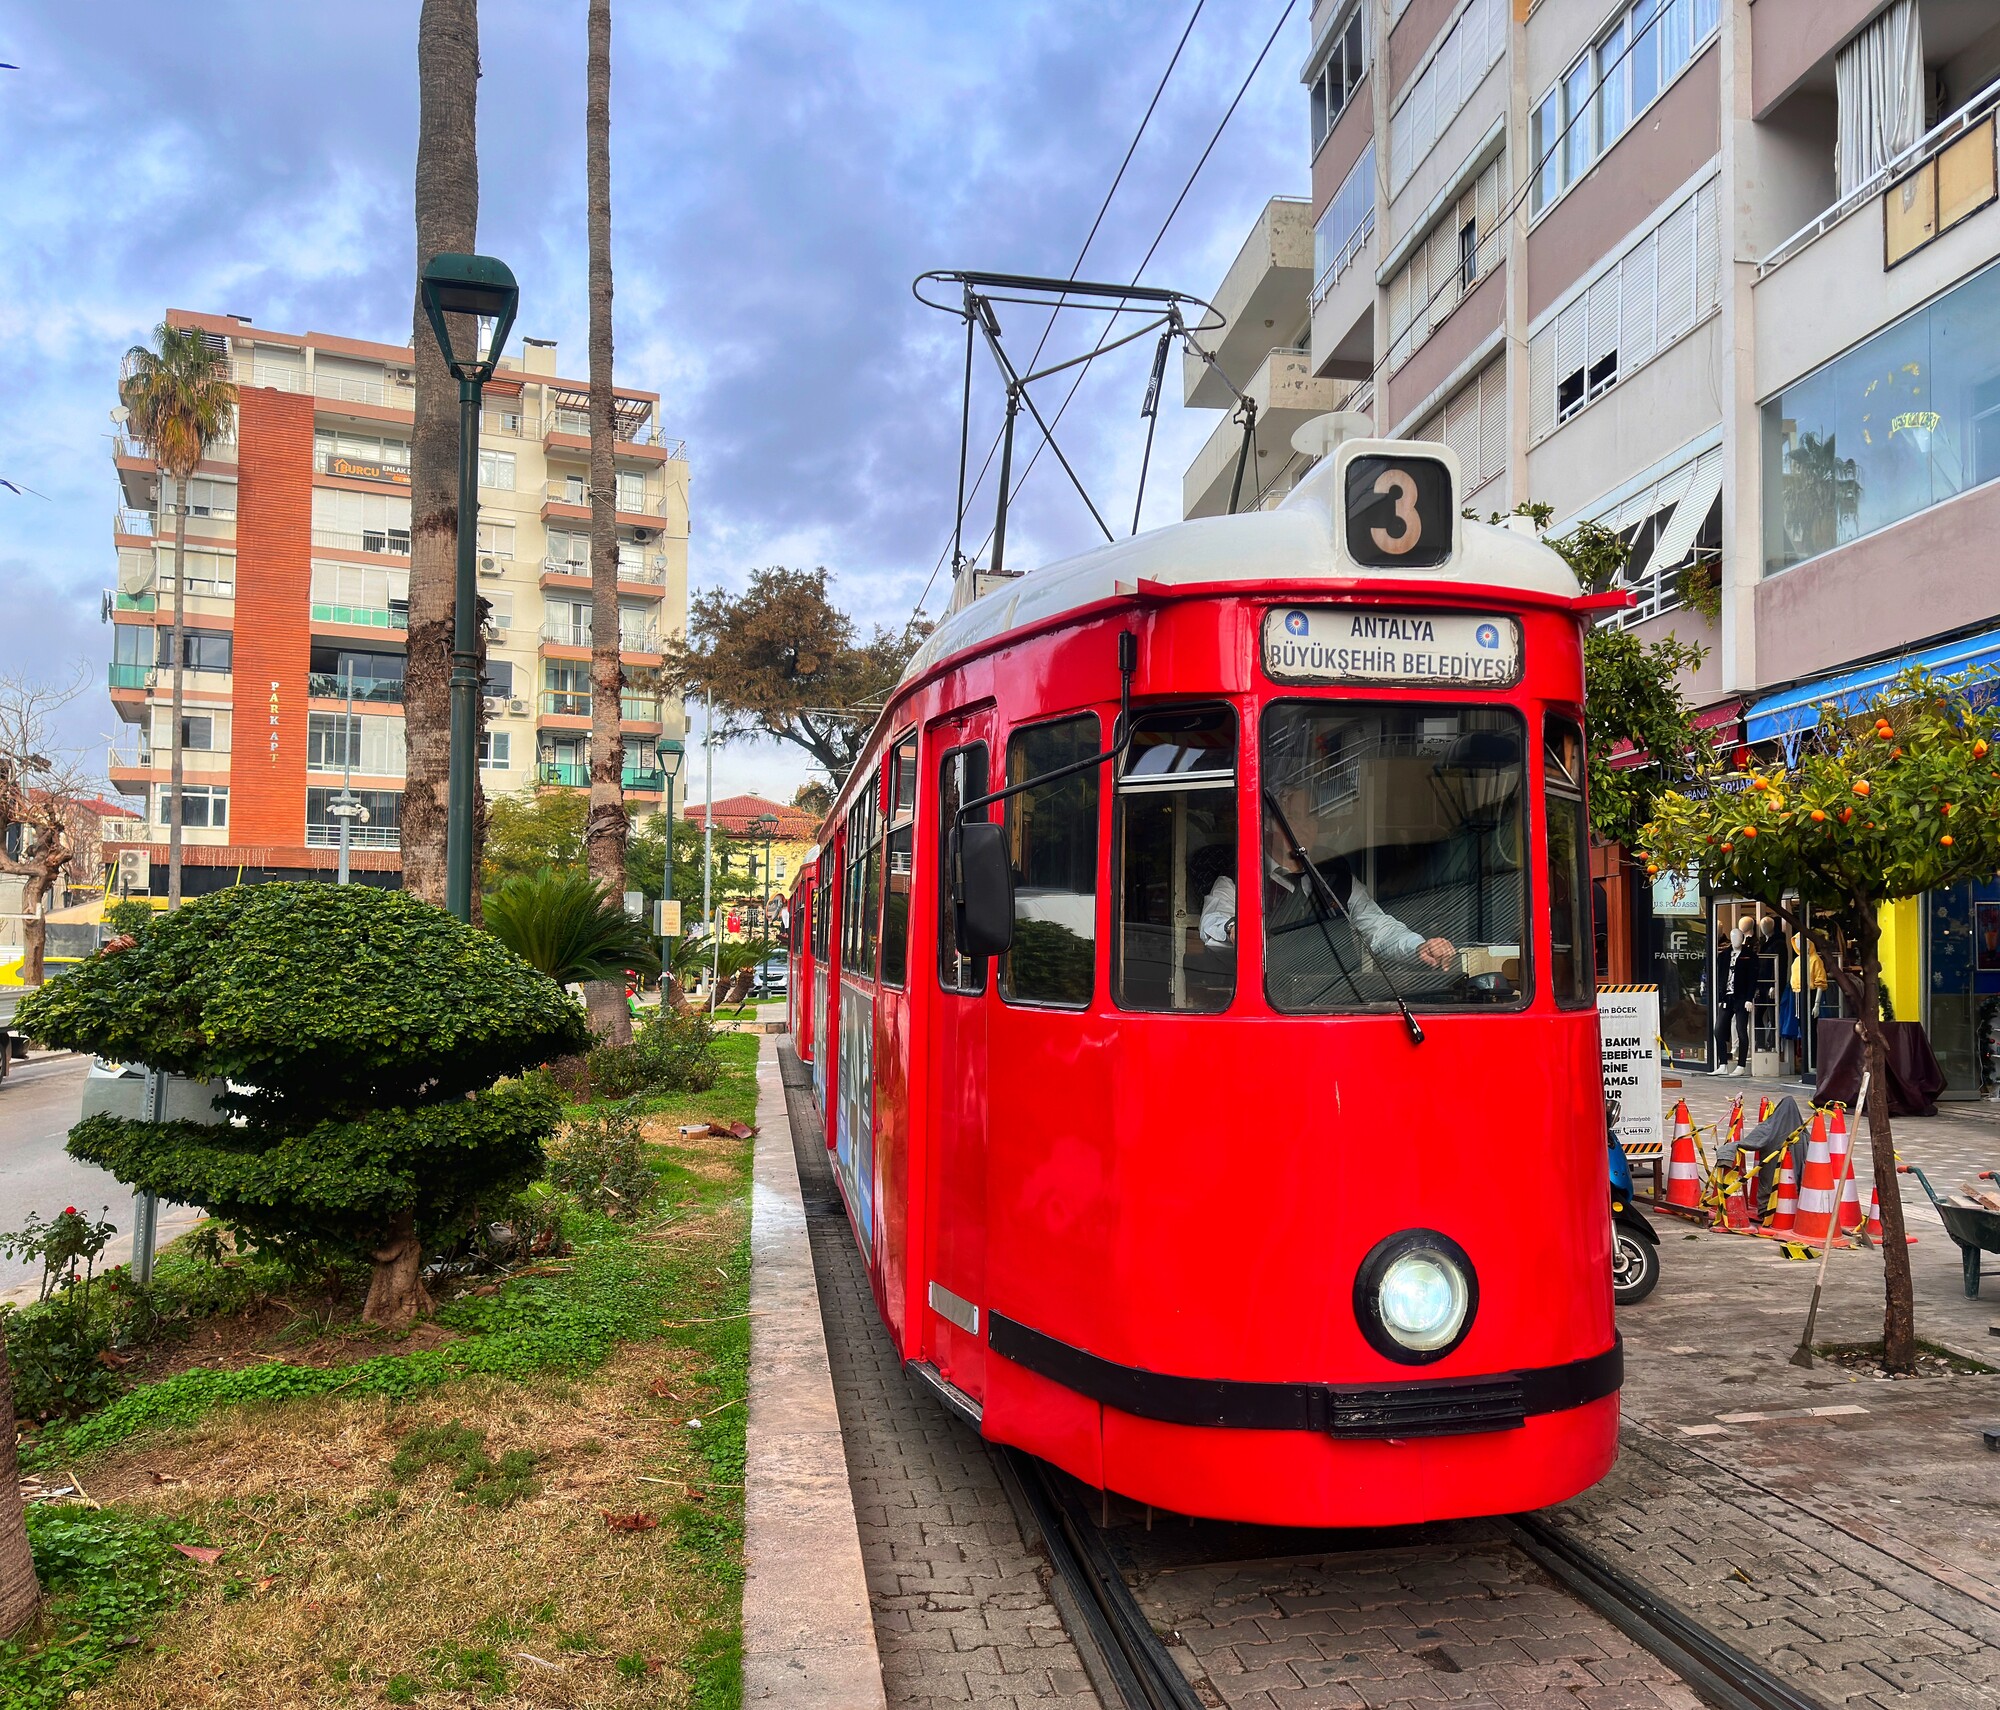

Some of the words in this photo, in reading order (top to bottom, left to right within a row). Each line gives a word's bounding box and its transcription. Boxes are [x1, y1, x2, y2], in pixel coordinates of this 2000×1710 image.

[340, 463, 380, 477] BURCU
[382, 465, 406, 474] EMLAK
[1370, 469, 1422, 555] 3
[1350, 616, 1434, 642] ANTALYA
[1271, 641, 1396, 675] BÜYÜKŞEHİR
[1403, 652, 1515, 679] BELEDİYESİ
[269, 681, 280, 725] PARK
[1654, 952, 1704, 960] FARFETCH
[1599, 1006, 1609, 1014] tin
[1611, 1005, 1637, 1014] BÖCEK
[1605, 1037, 1641, 1047] BAKIM
[1602, 1049, 1653, 1060] EBEBİYLE
[1603, 1062, 1628, 1073] RİNE
[1604, 1076, 1638, 1087] AMASI
[1605, 1090, 1622, 1099] UR
